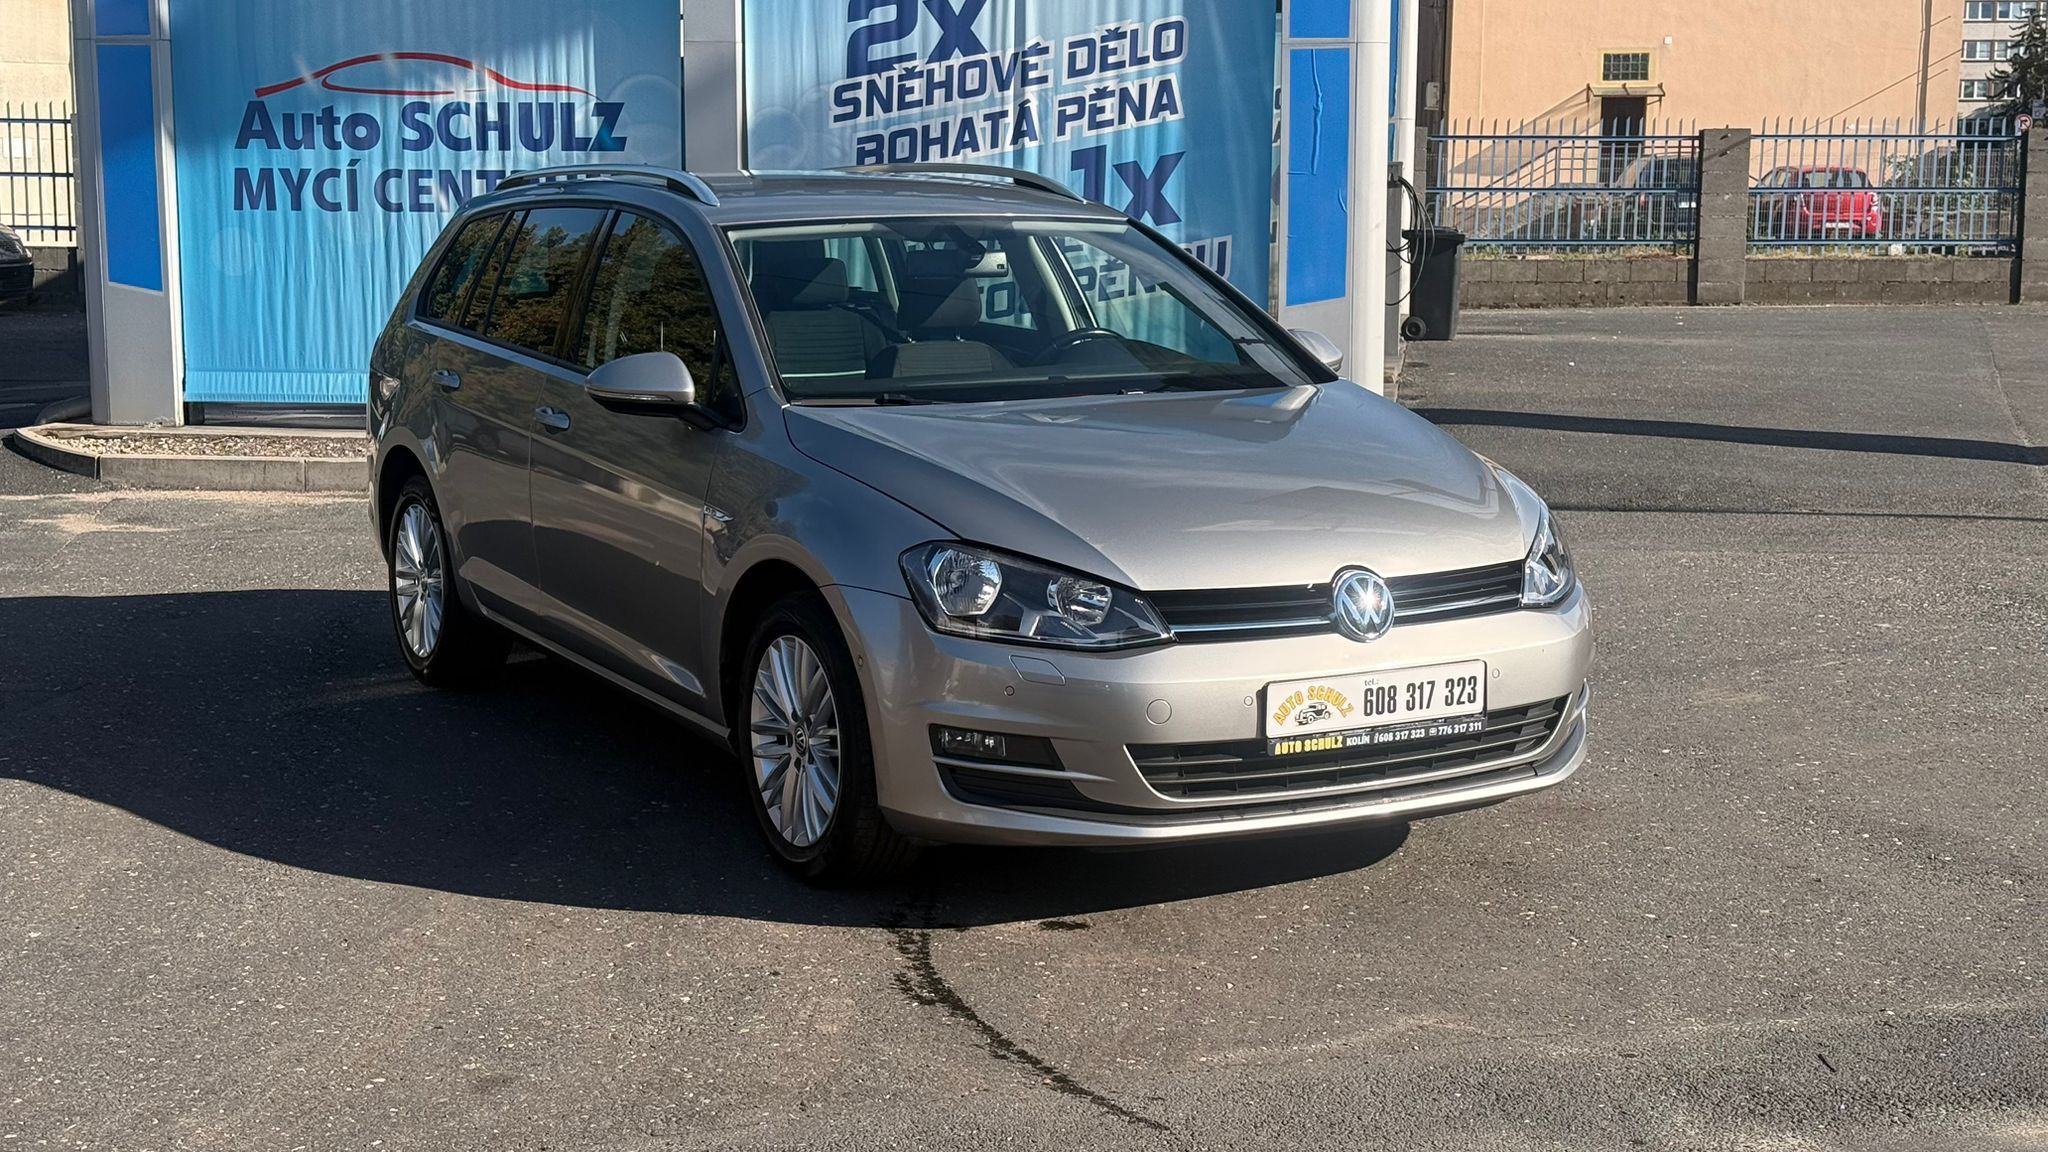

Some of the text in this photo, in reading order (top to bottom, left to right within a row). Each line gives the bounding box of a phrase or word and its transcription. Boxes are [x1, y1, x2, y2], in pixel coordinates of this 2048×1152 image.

[833, 20, 1183, 123] SNĚHOVÉ DĚLO
[235, 101, 627, 152] Auto SCHULZ
[856, 79, 1179, 165] BOHATÁ PĚNA
[233, 159, 361, 211] MYCÍ
[1273, 685, 1355, 726] AUTO SCHULZ
[1364, 676, 1477, 716] 608 317 323
[1275, 722, 1482, 755] AUTO SCHULZ KOLÍN 608 317 323 776 317 311
